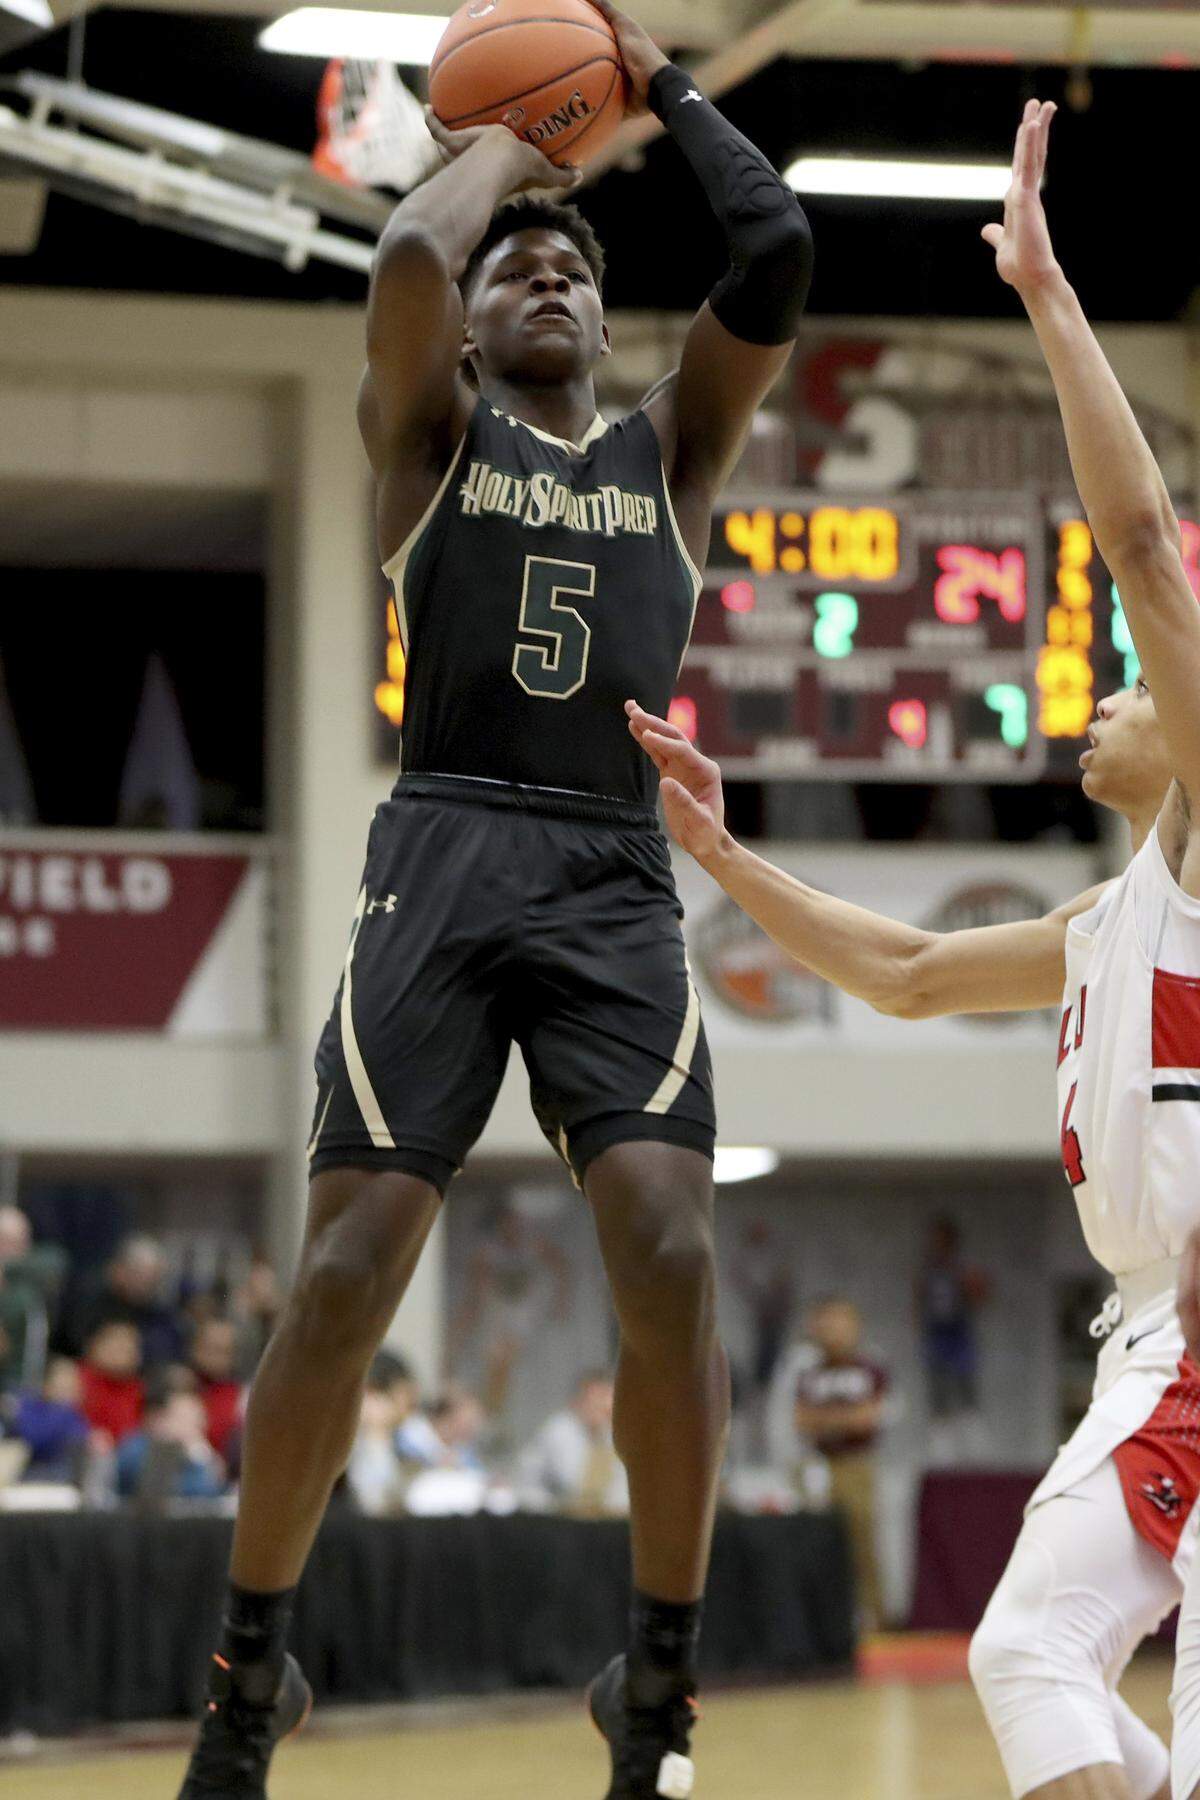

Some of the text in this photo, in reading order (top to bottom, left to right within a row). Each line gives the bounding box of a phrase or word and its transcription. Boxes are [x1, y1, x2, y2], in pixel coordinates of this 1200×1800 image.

[724, 506, 900, 582] 4:00
[934, 544, 1028, 624] 24
[511, 553, 596, 700] 5
[0, 856, 173, 915] IELD
